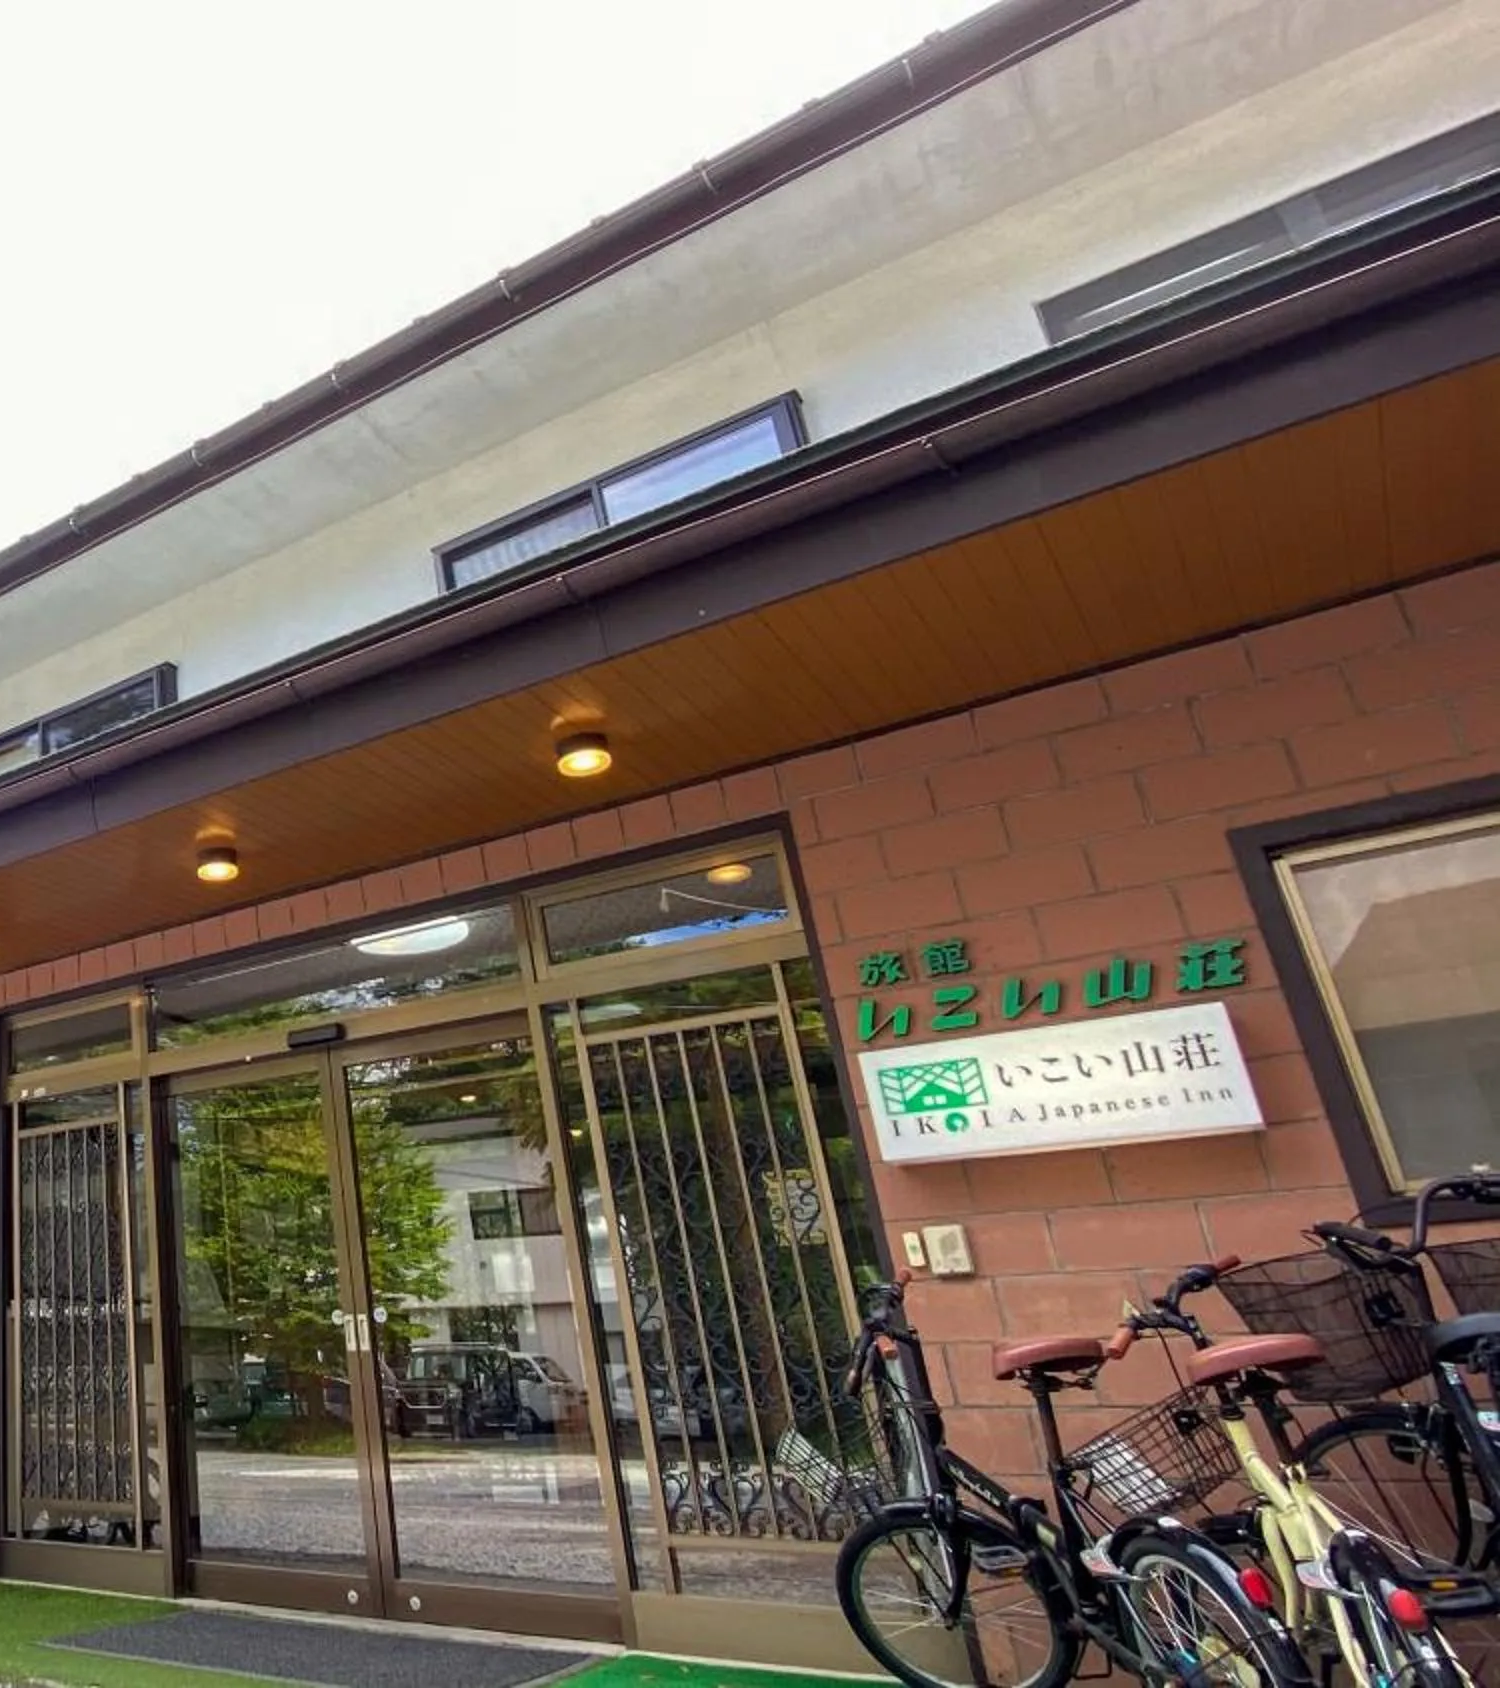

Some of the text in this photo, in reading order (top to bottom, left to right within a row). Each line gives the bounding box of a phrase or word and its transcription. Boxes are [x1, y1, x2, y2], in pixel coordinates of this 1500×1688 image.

[857, 938, 973, 987] 旅館
[856, 938, 1247, 1043] いこい山荘
[996, 1031, 1222, 1088] いこい山荘
[1037, 1093, 1172, 1122] Japanese
[1181, 1086, 1234, 1104] Inn
